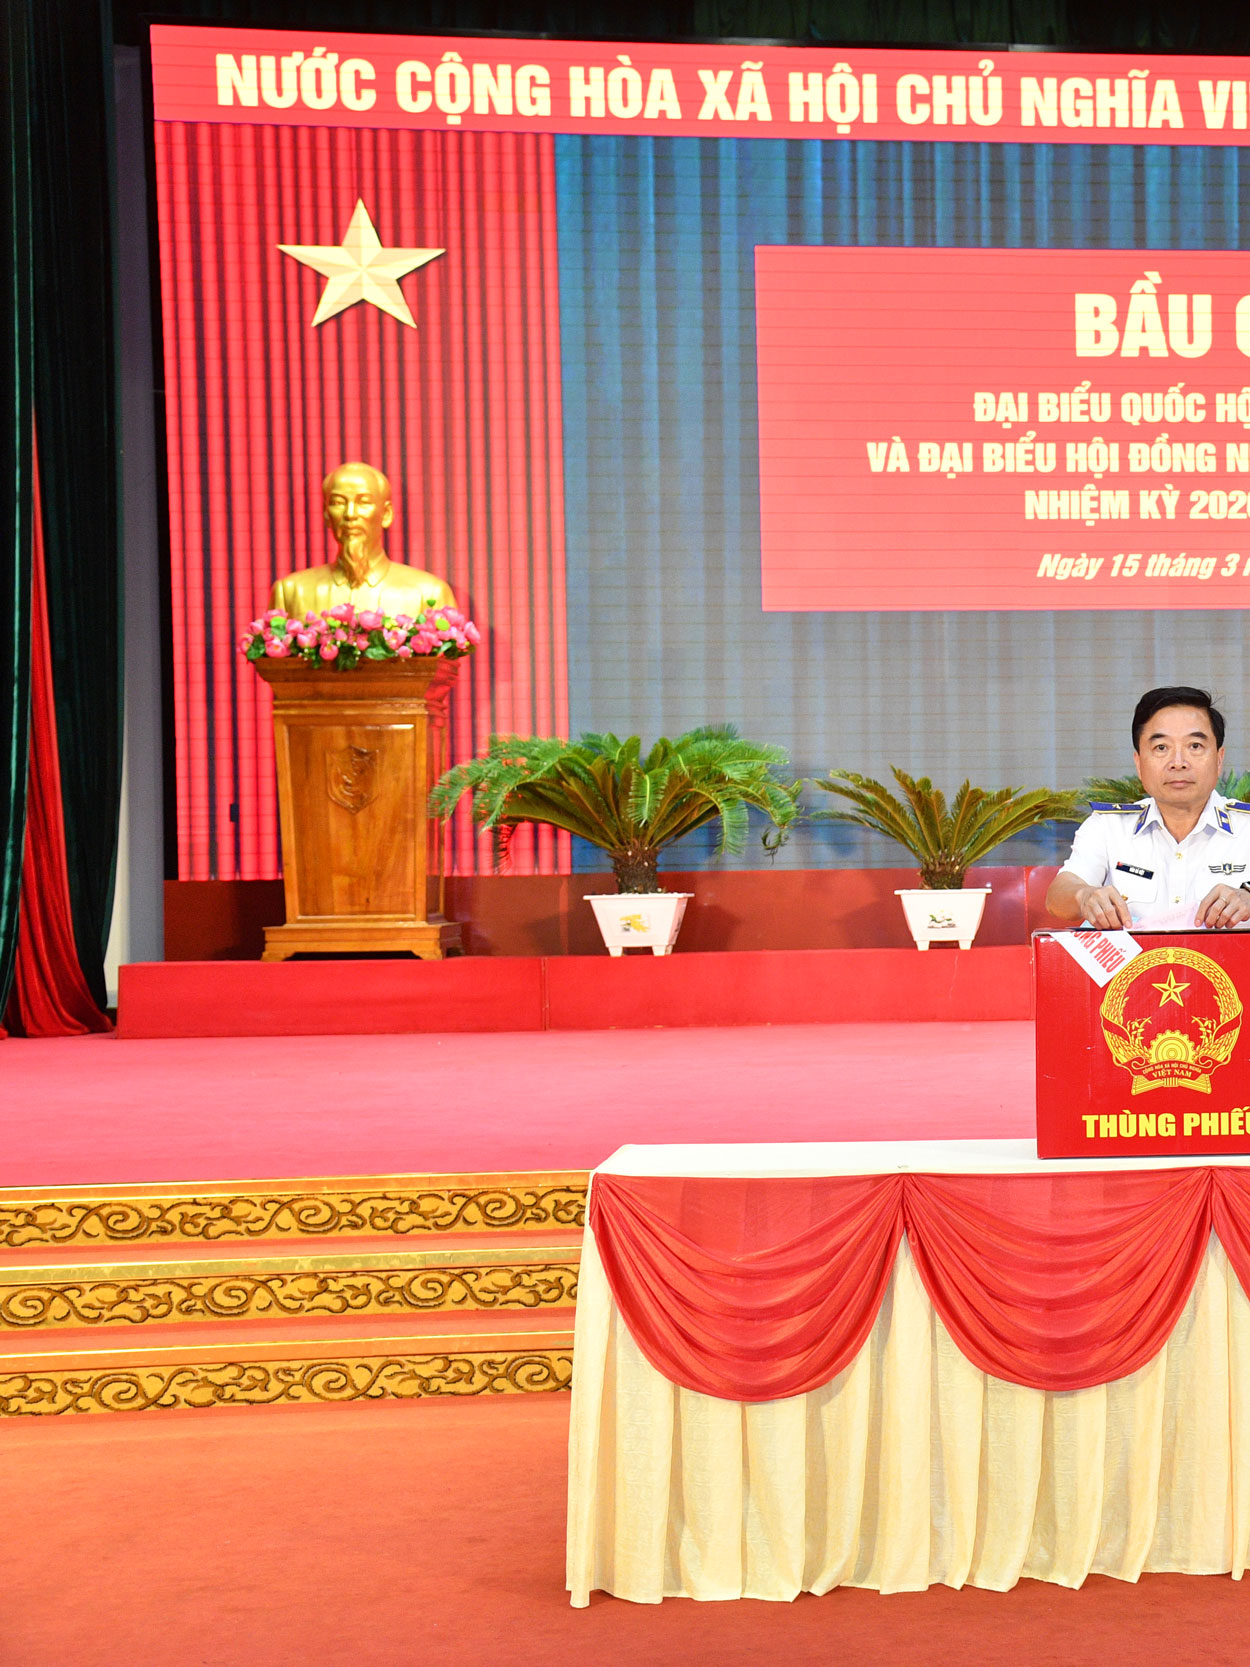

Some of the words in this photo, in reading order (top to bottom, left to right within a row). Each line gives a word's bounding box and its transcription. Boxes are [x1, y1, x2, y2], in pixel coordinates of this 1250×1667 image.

[216, 47, 376, 111] NƯỚC
[396, 52, 550, 124] CỘNG
[570, 55, 681, 119] HÒA
[698, 61, 772, 121] XÃ
[789, 63, 877, 133] HỘI
[897, 59, 1002, 126] CHỦ
[1021, 70, 1184, 128] NGHĨA
[1075, 272, 1212, 358] BẦU
[973, 392, 1028, 428] ĐẠI
[1038, 381, 1111, 422] BIỂU
[1121, 383, 1206, 425] QUỐC
[867, 436, 910, 472] VÀ
[918, 443, 973, 479] ĐẠI
[983, 431, 1056, 472] BIỂU
[1066, 437, 1119, 478] HỘI
[1128, 433, 1216, 472] ĐỒNG
[1025, 484, 1129, 526] NHIỆM
[1140, 484, 1180, 519] KỲ
[1037, 553, 1104, 580] Ngày
[1111, 554, 1142, 577] 15
[1145, 553, 1217, 579] tháng
[1221, 553, 1240, 576] 3
[1152, 1069, 1172, 1078] VIỆT
[1173, 1069, 1192, 1078] NAM
[1082, 1110, 1175, 1137] THÙNG
